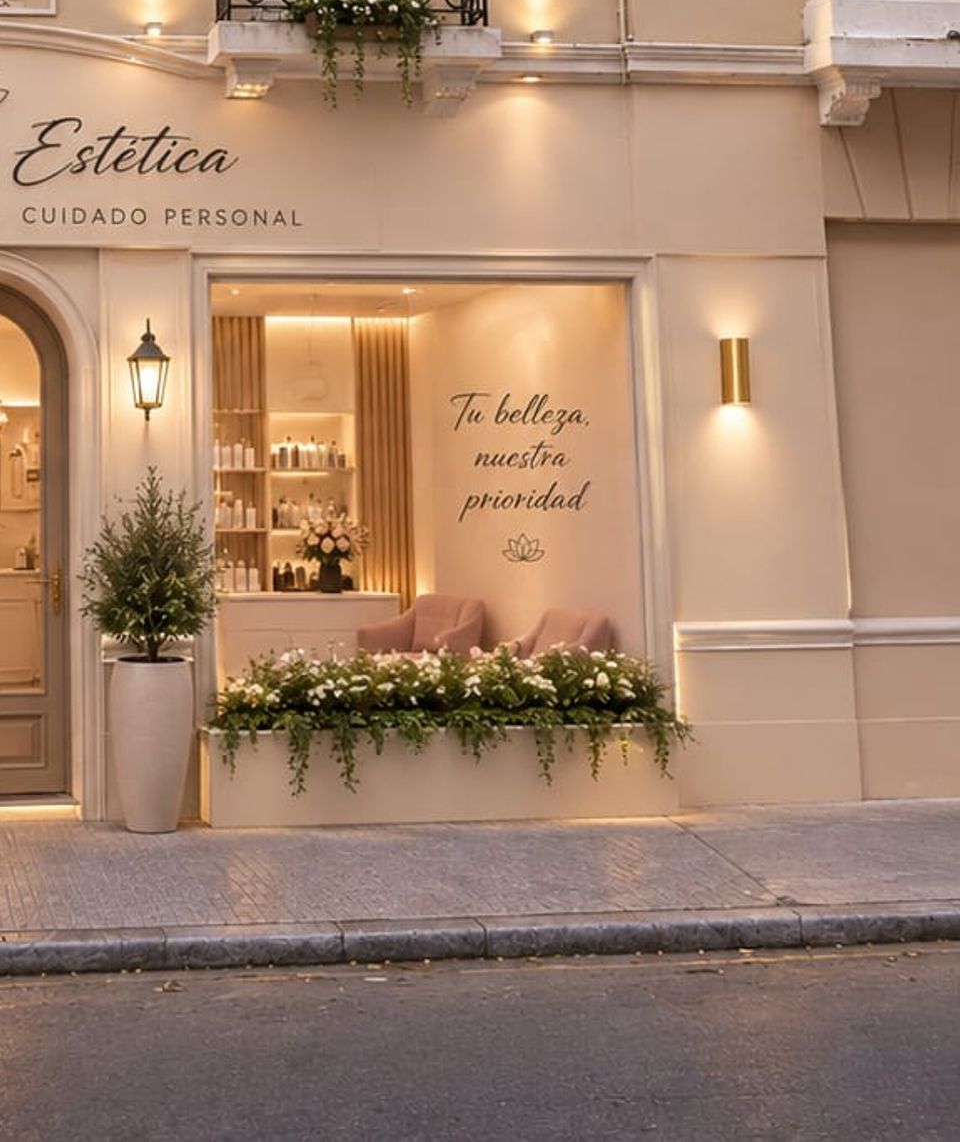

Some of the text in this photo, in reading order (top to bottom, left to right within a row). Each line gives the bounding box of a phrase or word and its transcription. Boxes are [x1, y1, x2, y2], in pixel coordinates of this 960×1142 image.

[12, 117, 239, 187] Estética
[21, 206, 147, 226] CUIDADO
[164, 207, 303, 227] PERSONAL
[450, 392, 488, 431] Tu
[475, 440, 571, 470] nuestra
[459, 481, 591, 522] prioridad
